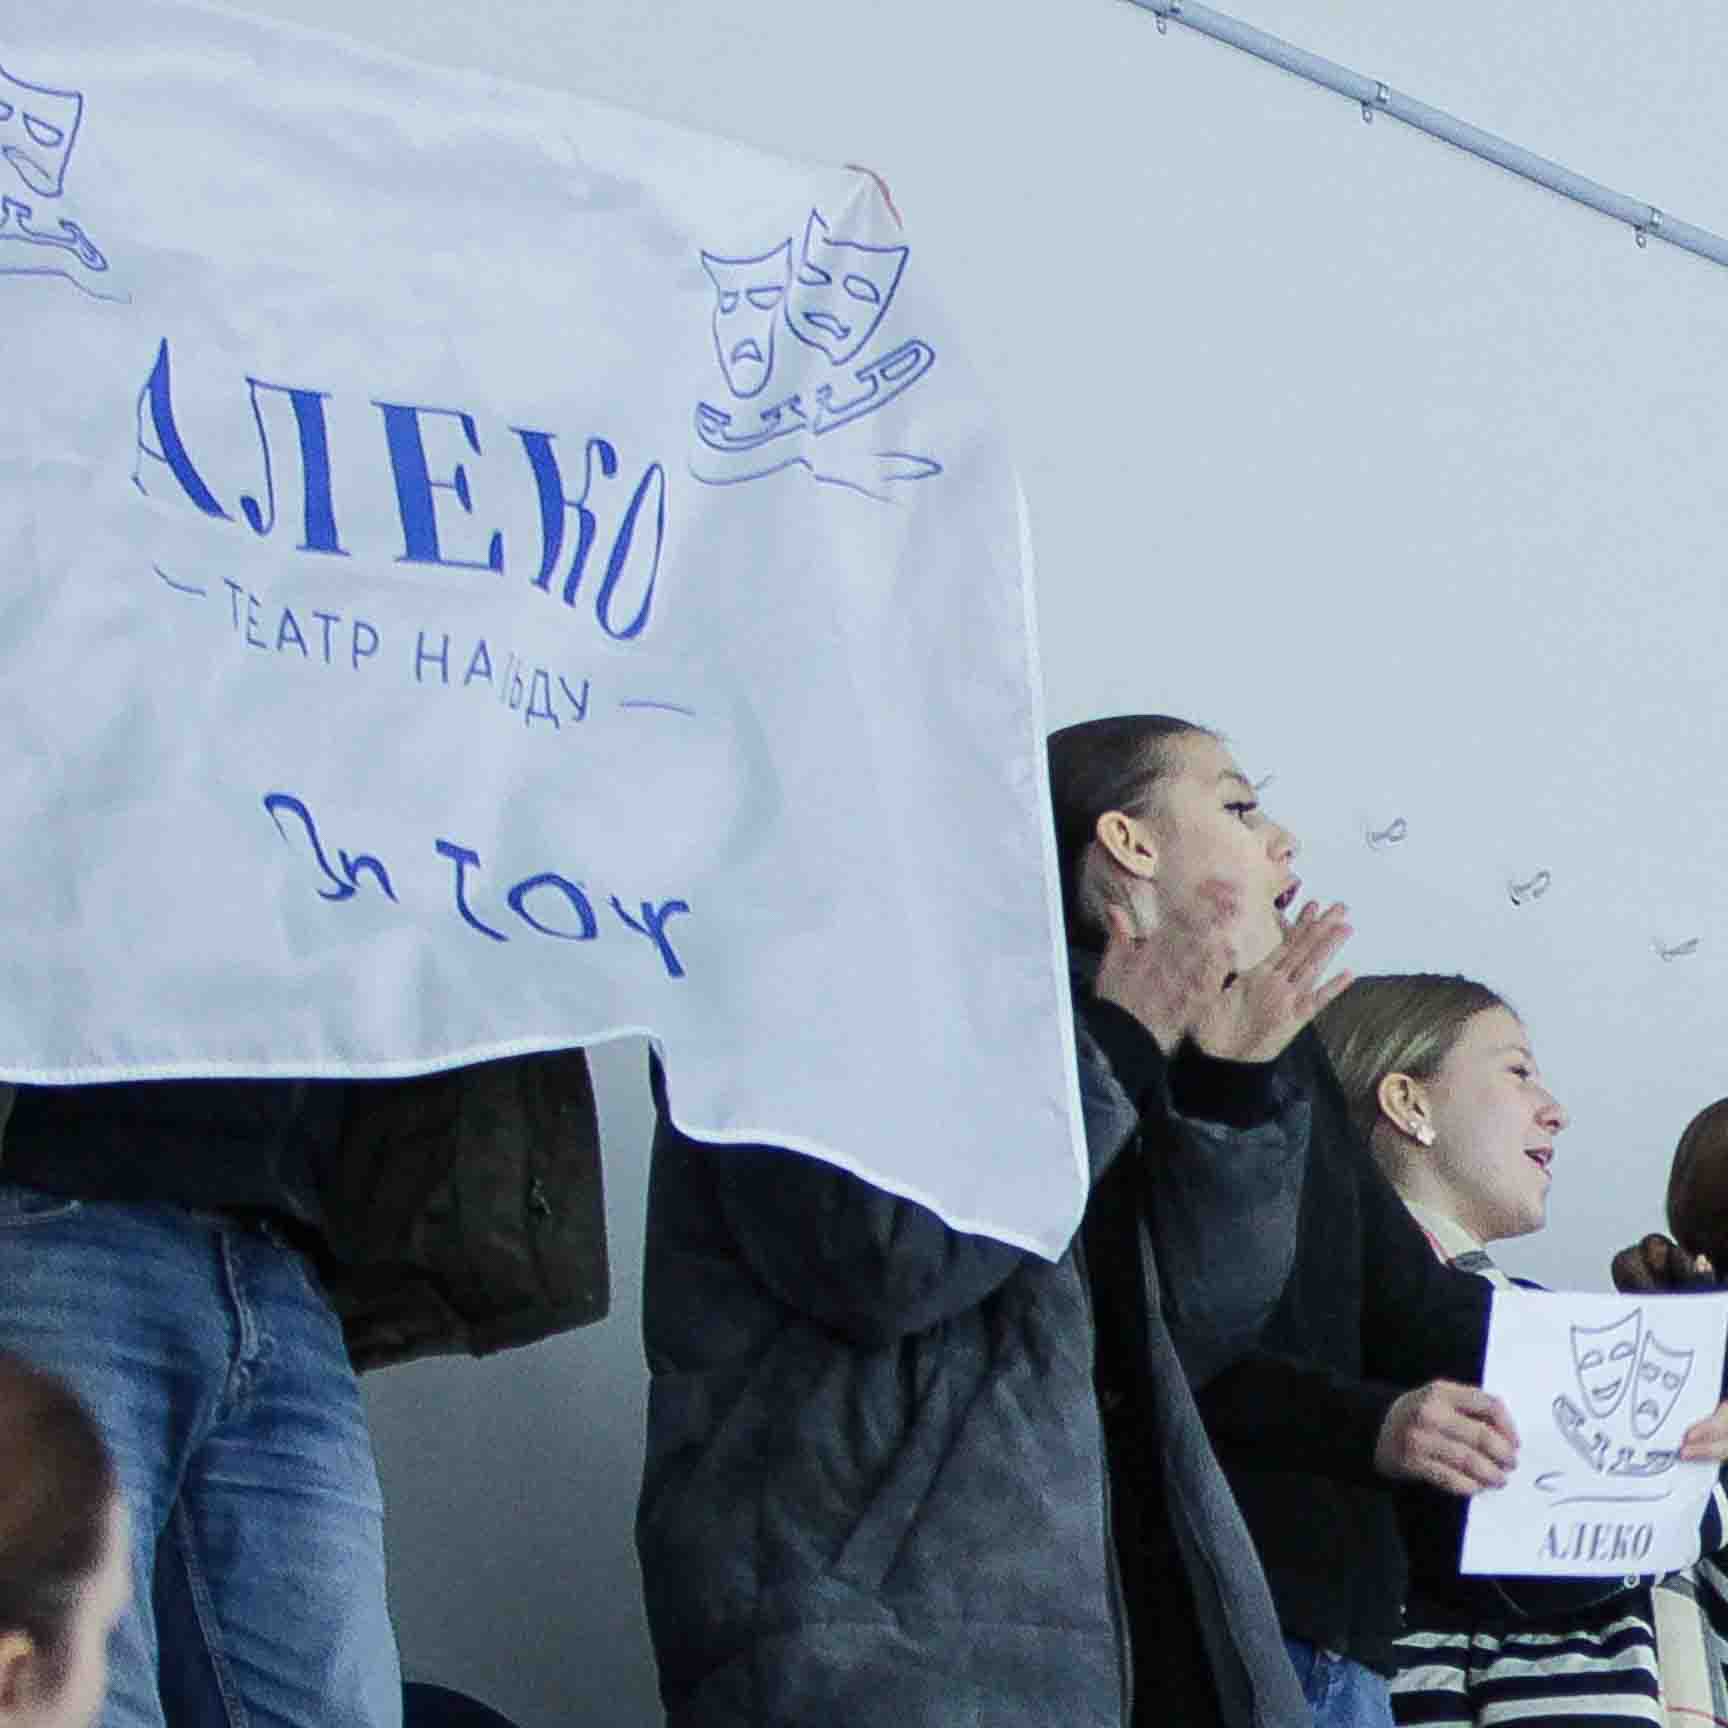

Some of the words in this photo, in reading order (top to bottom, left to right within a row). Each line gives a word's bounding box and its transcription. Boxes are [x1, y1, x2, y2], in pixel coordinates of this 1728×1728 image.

[129, 337, 666, 640] АЛЕКО
[223, 576, 381, 669] ТЕАТР
[415, 631, 494, 685] НА
[1537, 1522, 1655, 1562] АЛЕКО
